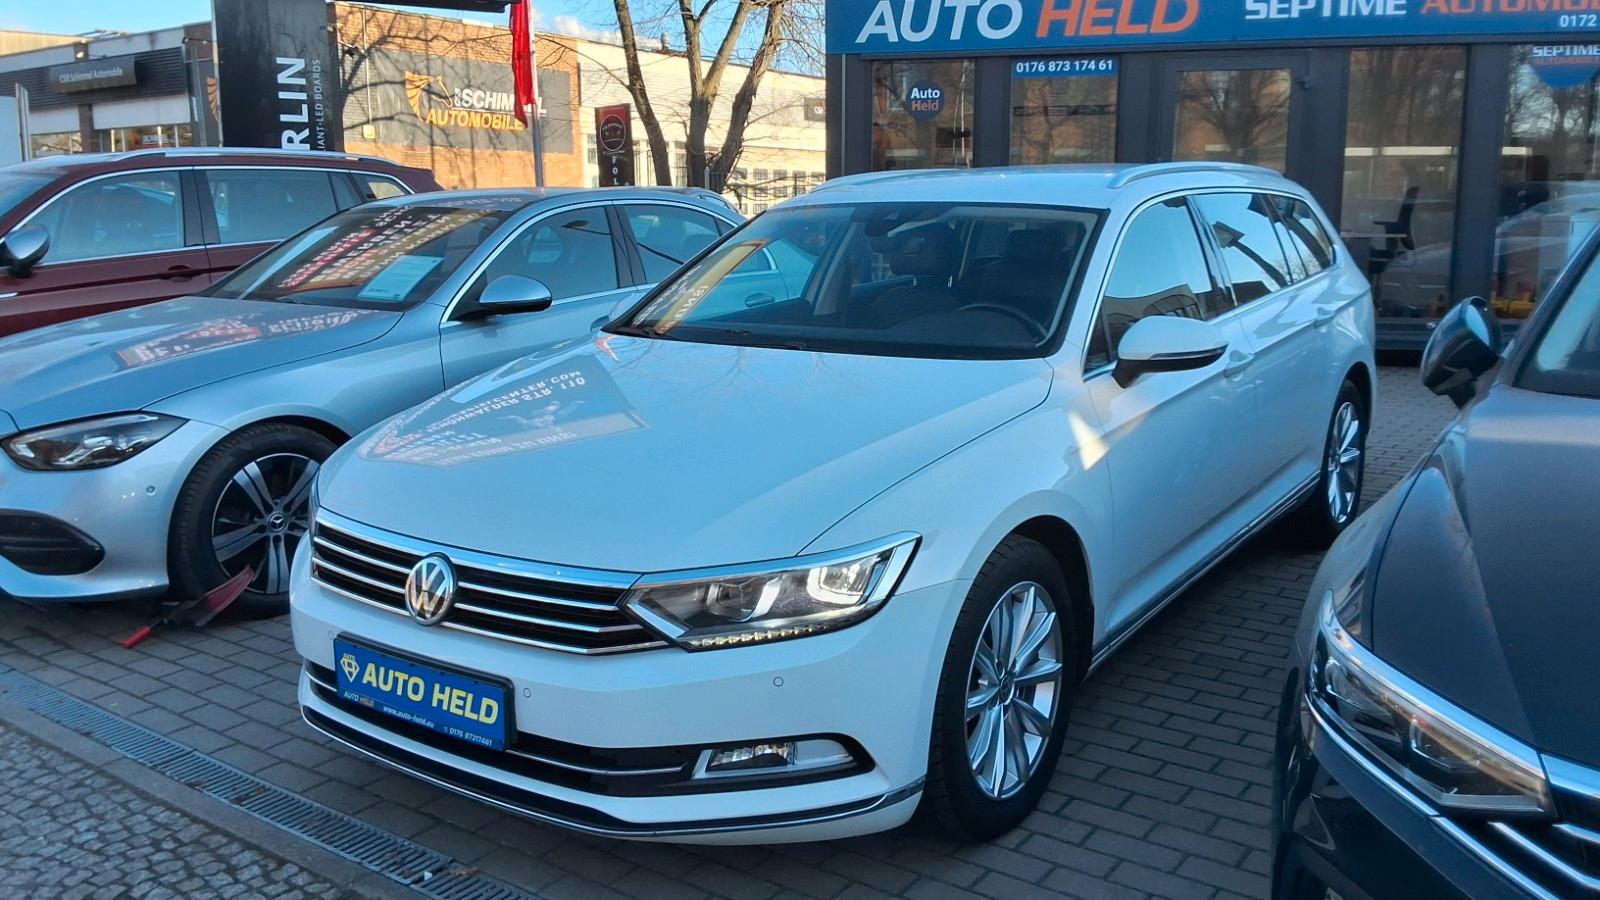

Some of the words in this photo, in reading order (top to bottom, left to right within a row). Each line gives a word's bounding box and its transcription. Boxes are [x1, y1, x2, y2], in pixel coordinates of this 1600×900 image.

[1244, 0, 1408, 20] SEPTIME
[855, 0, 1023, 43] AUTO
[1036, 0, 1199, 38] HELD
[1560, 14, 1597, 27] 0172
[1532, 45, 1600, 56] SEPTIME
[1016, 62, 1046, 73] 0176
[1048, 61, 1071, 72] 873
[1074, 60, 1096, 71] 174
[1098, 60, 1113, 70] 61
[312, 59, 323, 100] BOARDS
[911, 88, 940, 99] Auto
[912, 99, 939, 111] Held
[344, 691, 360, 702] AUTO
[362, 663, 425, 702] AUTO
[431, 683, 499, 725] HELD
